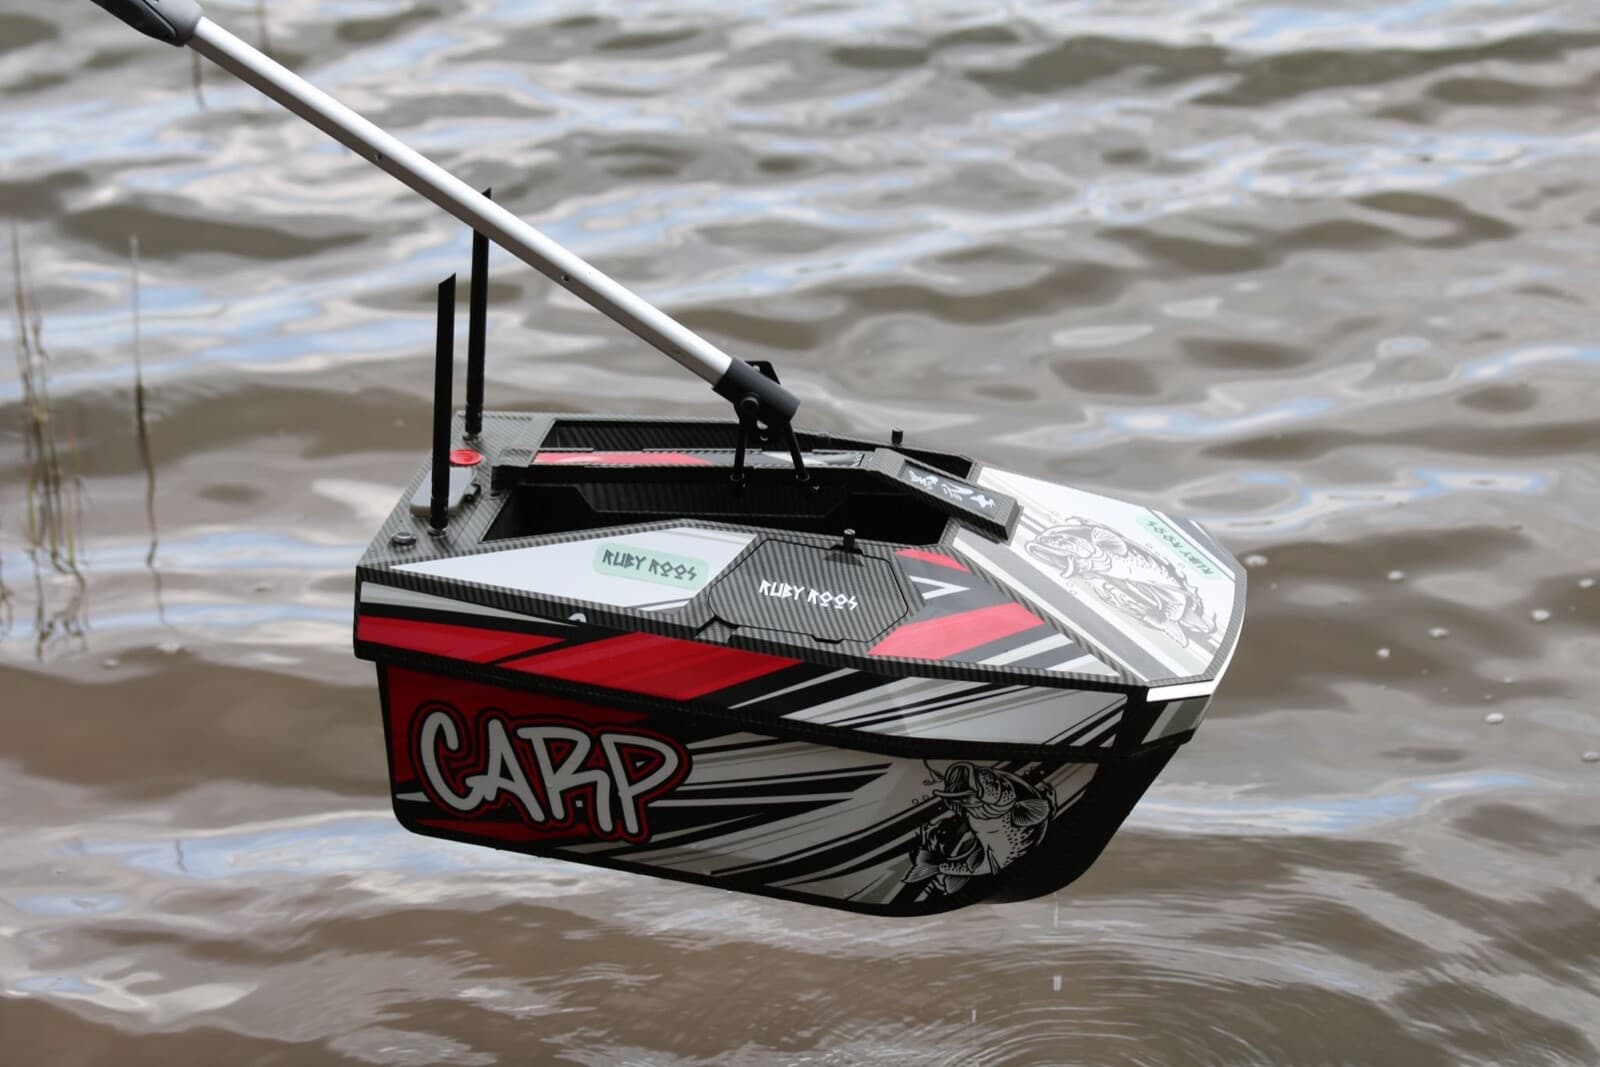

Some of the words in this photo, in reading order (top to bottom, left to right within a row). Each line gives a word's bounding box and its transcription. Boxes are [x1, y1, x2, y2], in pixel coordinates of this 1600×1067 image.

[602, 548, 647, 571] RUBY
[648, 558, 697, 581] ROOS
[759, 579, 805, 600] RUBY
[807, 588, 858, 611] ROOS
[420, 711, 679, 835] CARP
